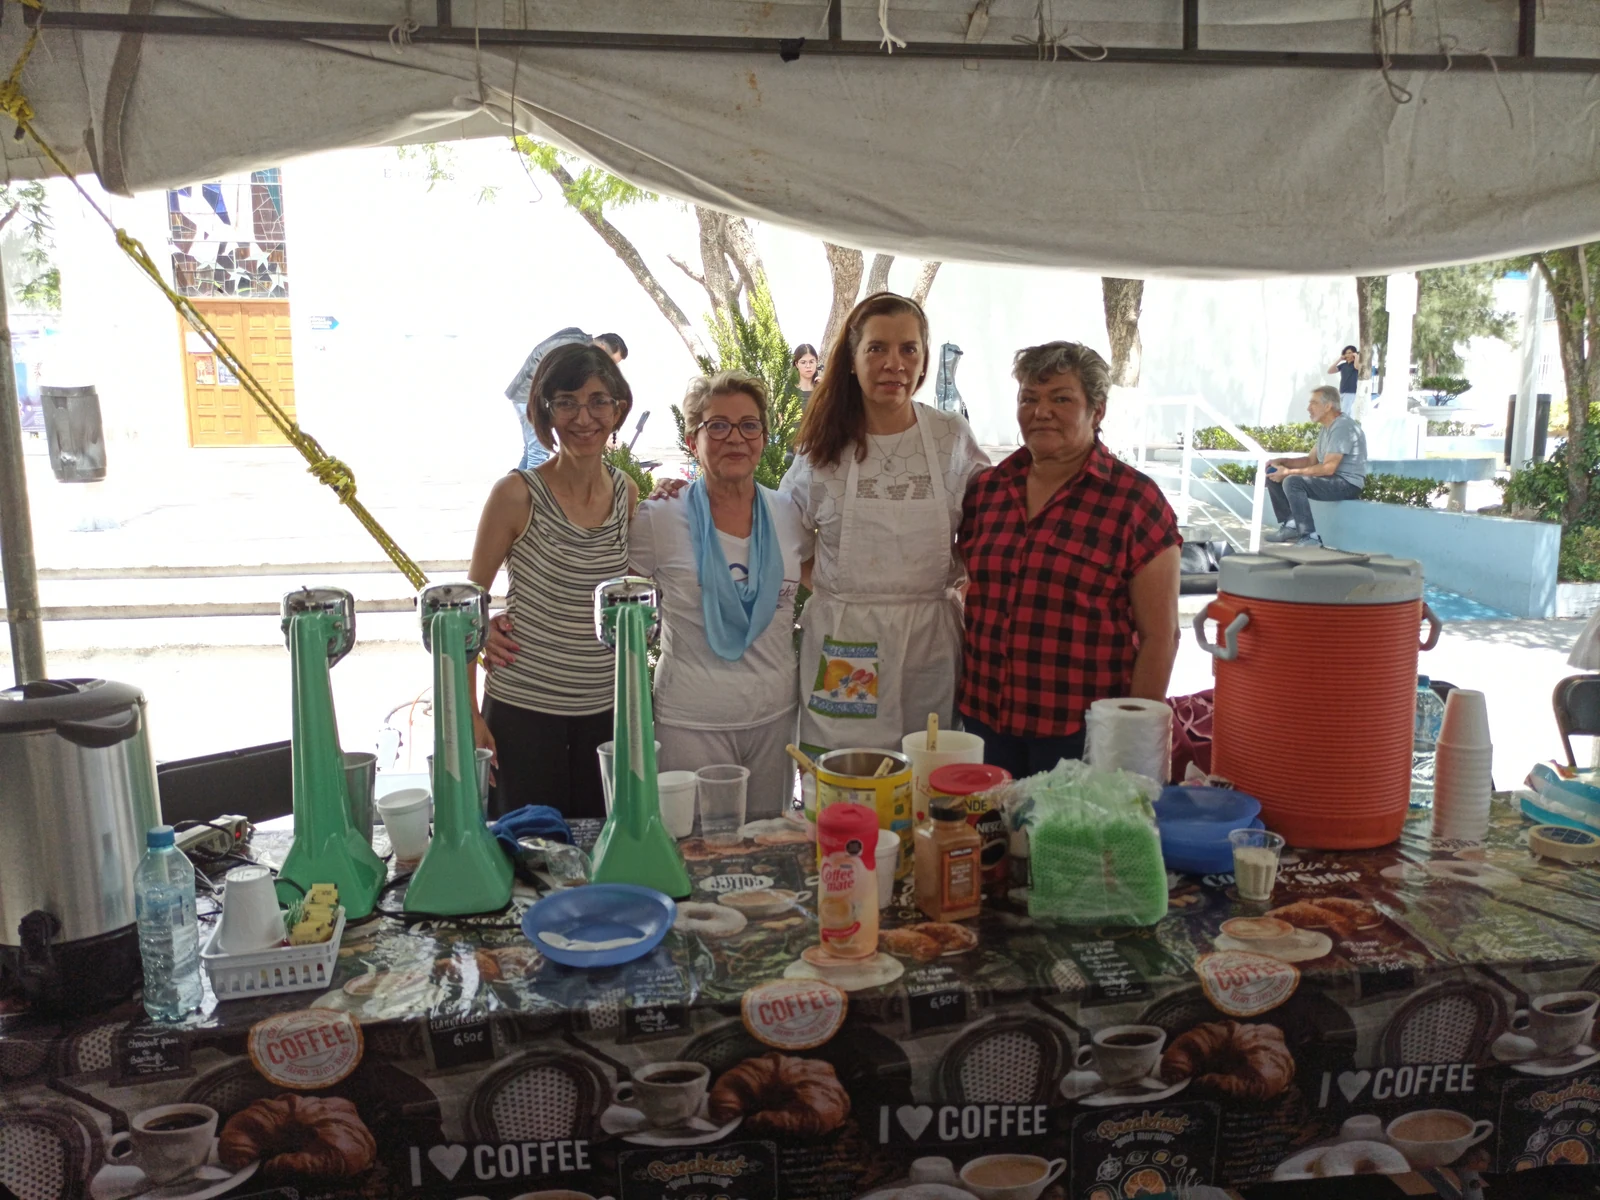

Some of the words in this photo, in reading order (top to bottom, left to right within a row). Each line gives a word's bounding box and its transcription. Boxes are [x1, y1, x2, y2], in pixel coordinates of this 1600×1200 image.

[821, 861, 854, 884] Coffee
[826, 879, 854, 892] mate
[758, 989, 837, 1026] COFFEE
[265, 1020, 352, 1065] COFFEE
[453, 1031, 485, 1047] 6,50€
[1317, 1071, 1332, 1108] I
[1372, 1063, 1477, 1100] COFFEE
[879, 1105, 890, 1145] I
[938, 1104, 1048, 1142] COFFEE
[1096, 1109, 1191, 1141] Breakfast
[1136, 1130, 1173, 1145] morning
[409, 1145, 422, 1187] I
[473, 1140, 592, 1181] COFFEE
[647, 1151, 749, 1182] Breakfast
[691, 1174, 731, 1189] morning
